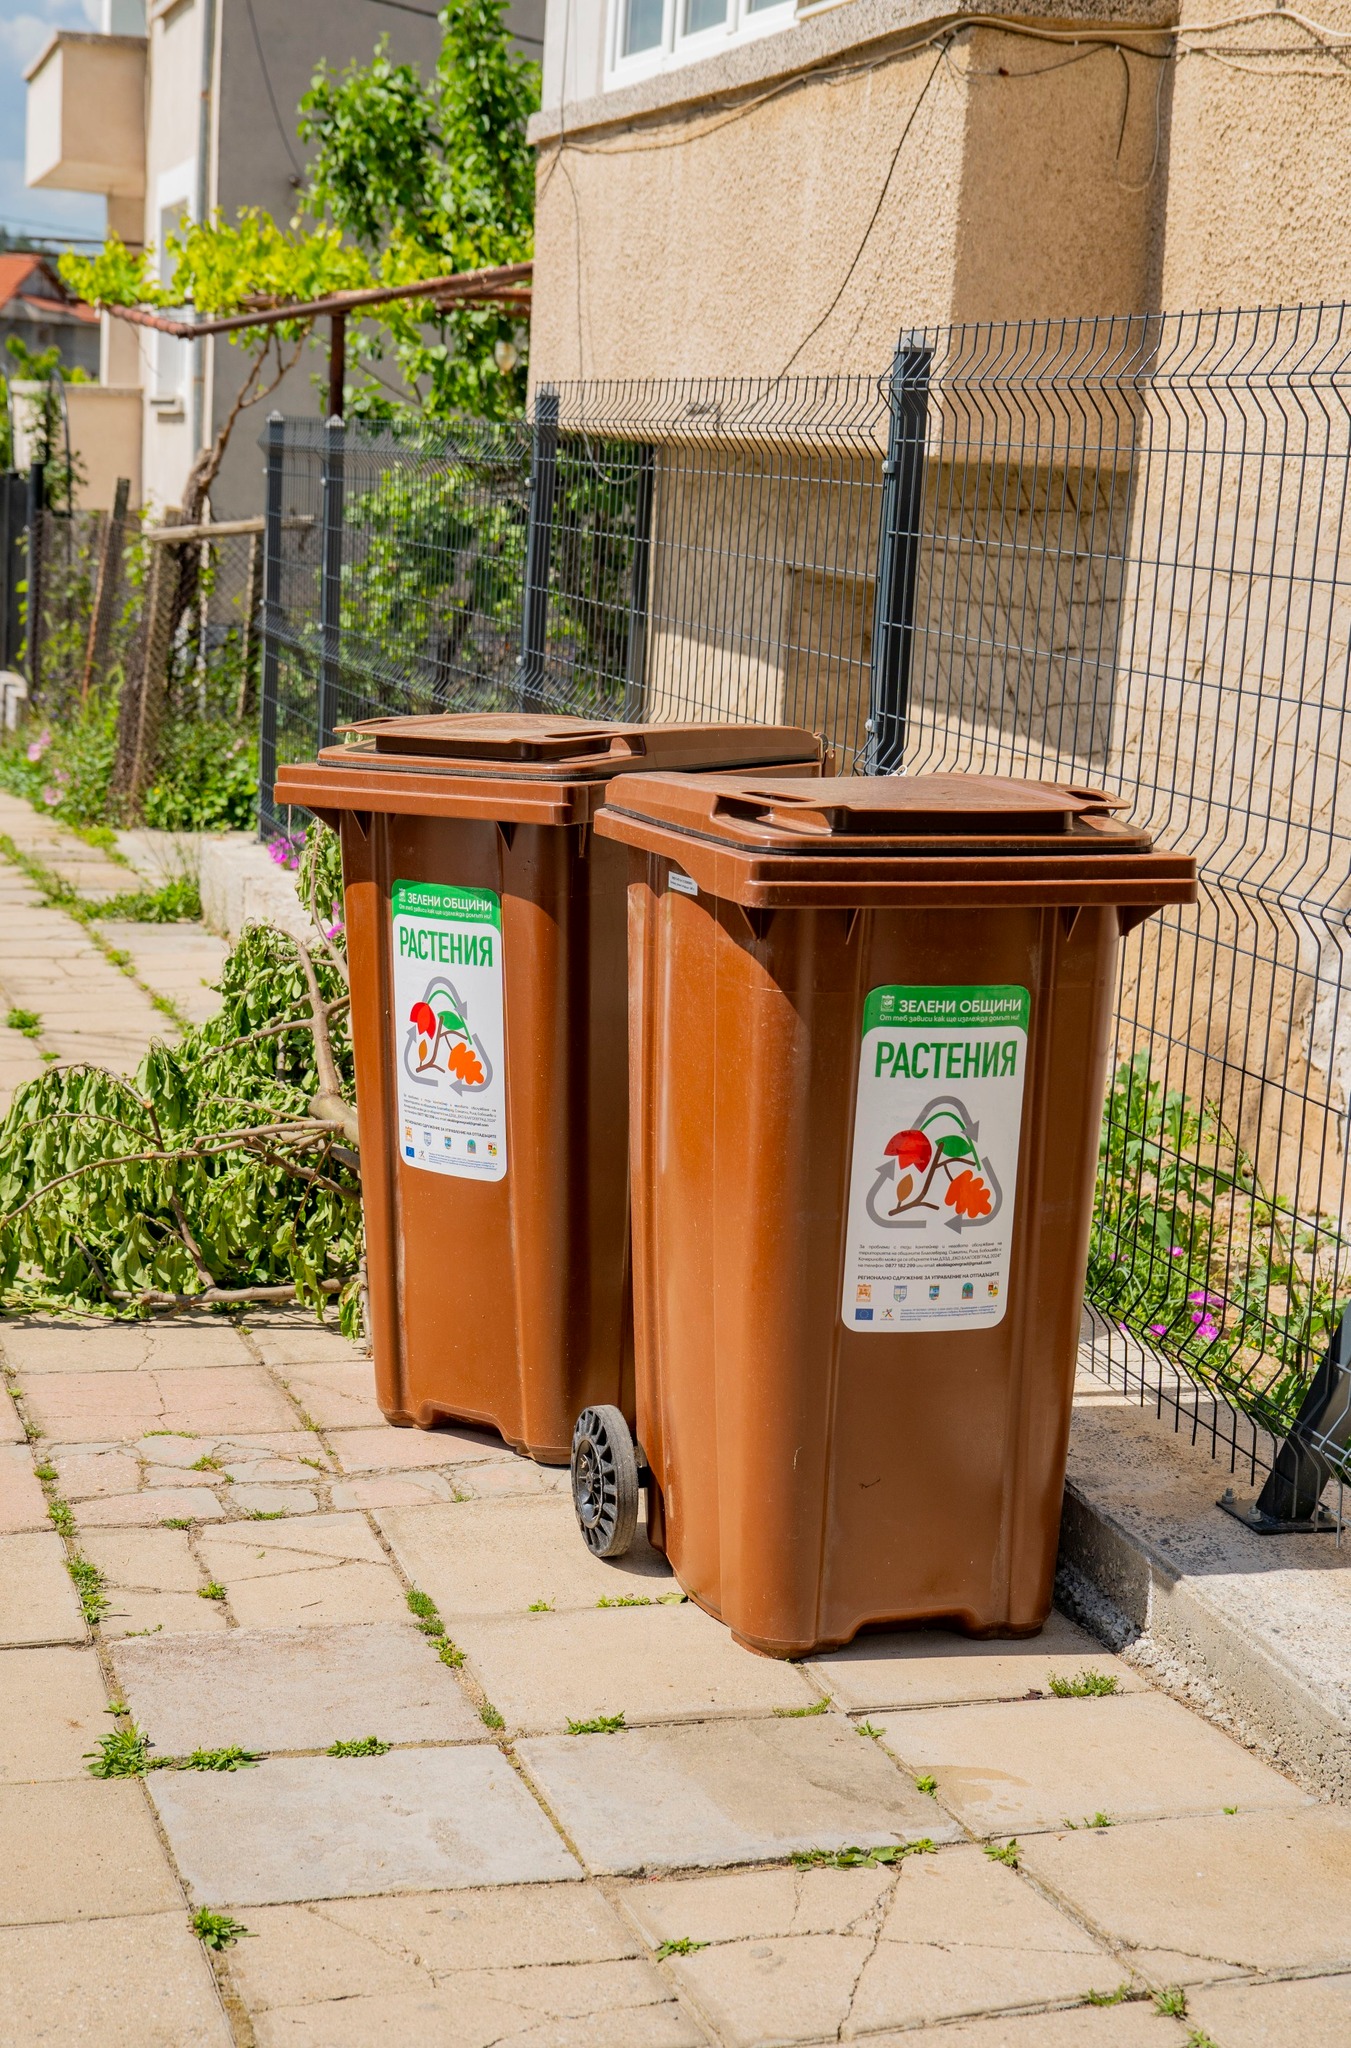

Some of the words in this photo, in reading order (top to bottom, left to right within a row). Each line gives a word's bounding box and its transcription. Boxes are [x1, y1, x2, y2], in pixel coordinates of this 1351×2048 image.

[407, 892, 441, 907] ЗЕЛЕНИ
[443, 897, 493, 911] ОБЩИНИ
[399, 926, 493, 968] РАСТЕНИЯ
[898, 1000, 956, 1014] ЗЕЛЕНИ
[959, 999, 1022, 1014] ОБЩИНИ
[874, 1040, 1018, 1079] РАСТЕНИЯ
